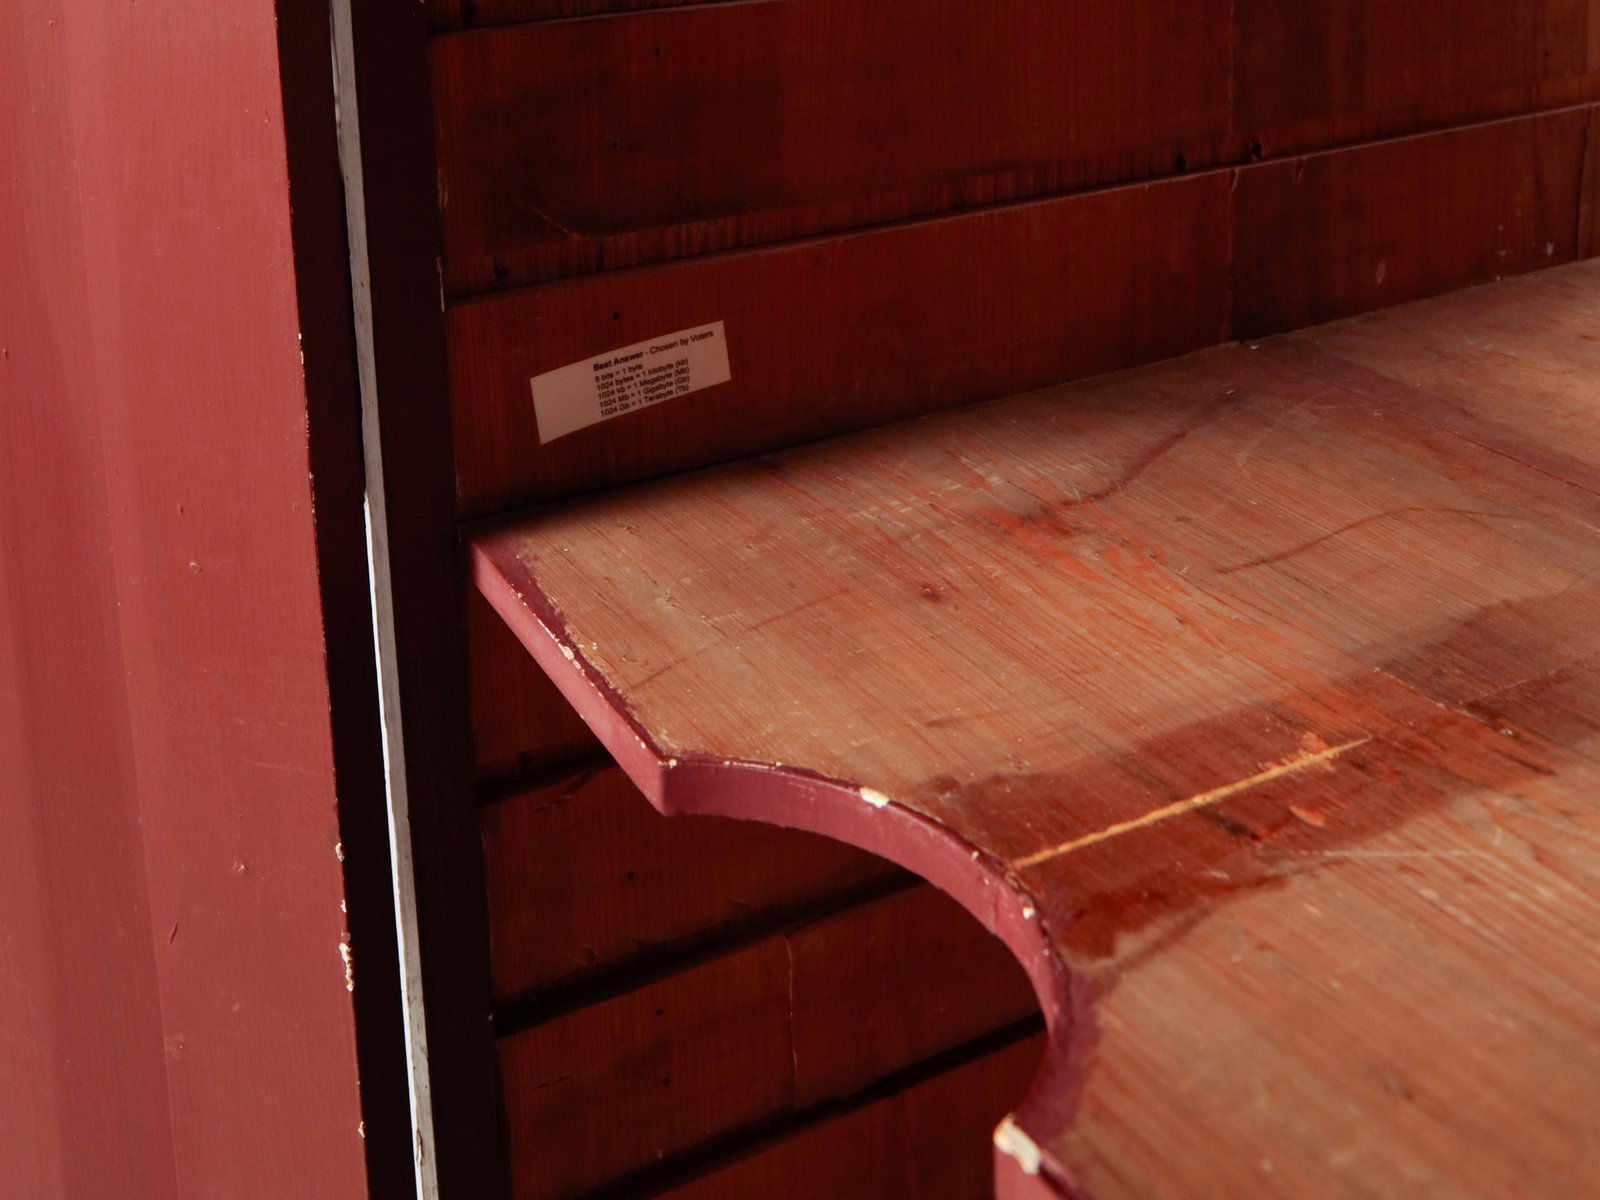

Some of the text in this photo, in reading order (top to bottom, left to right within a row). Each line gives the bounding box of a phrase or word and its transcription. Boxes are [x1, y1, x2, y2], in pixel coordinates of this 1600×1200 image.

[593, 362, 612, 371] Best
[614, 352, 643, 365] Answer
[650, 343, 678, 354] Chosen
[680, 338, 688, 346] by
[690, 331, 714, 342] Voters
